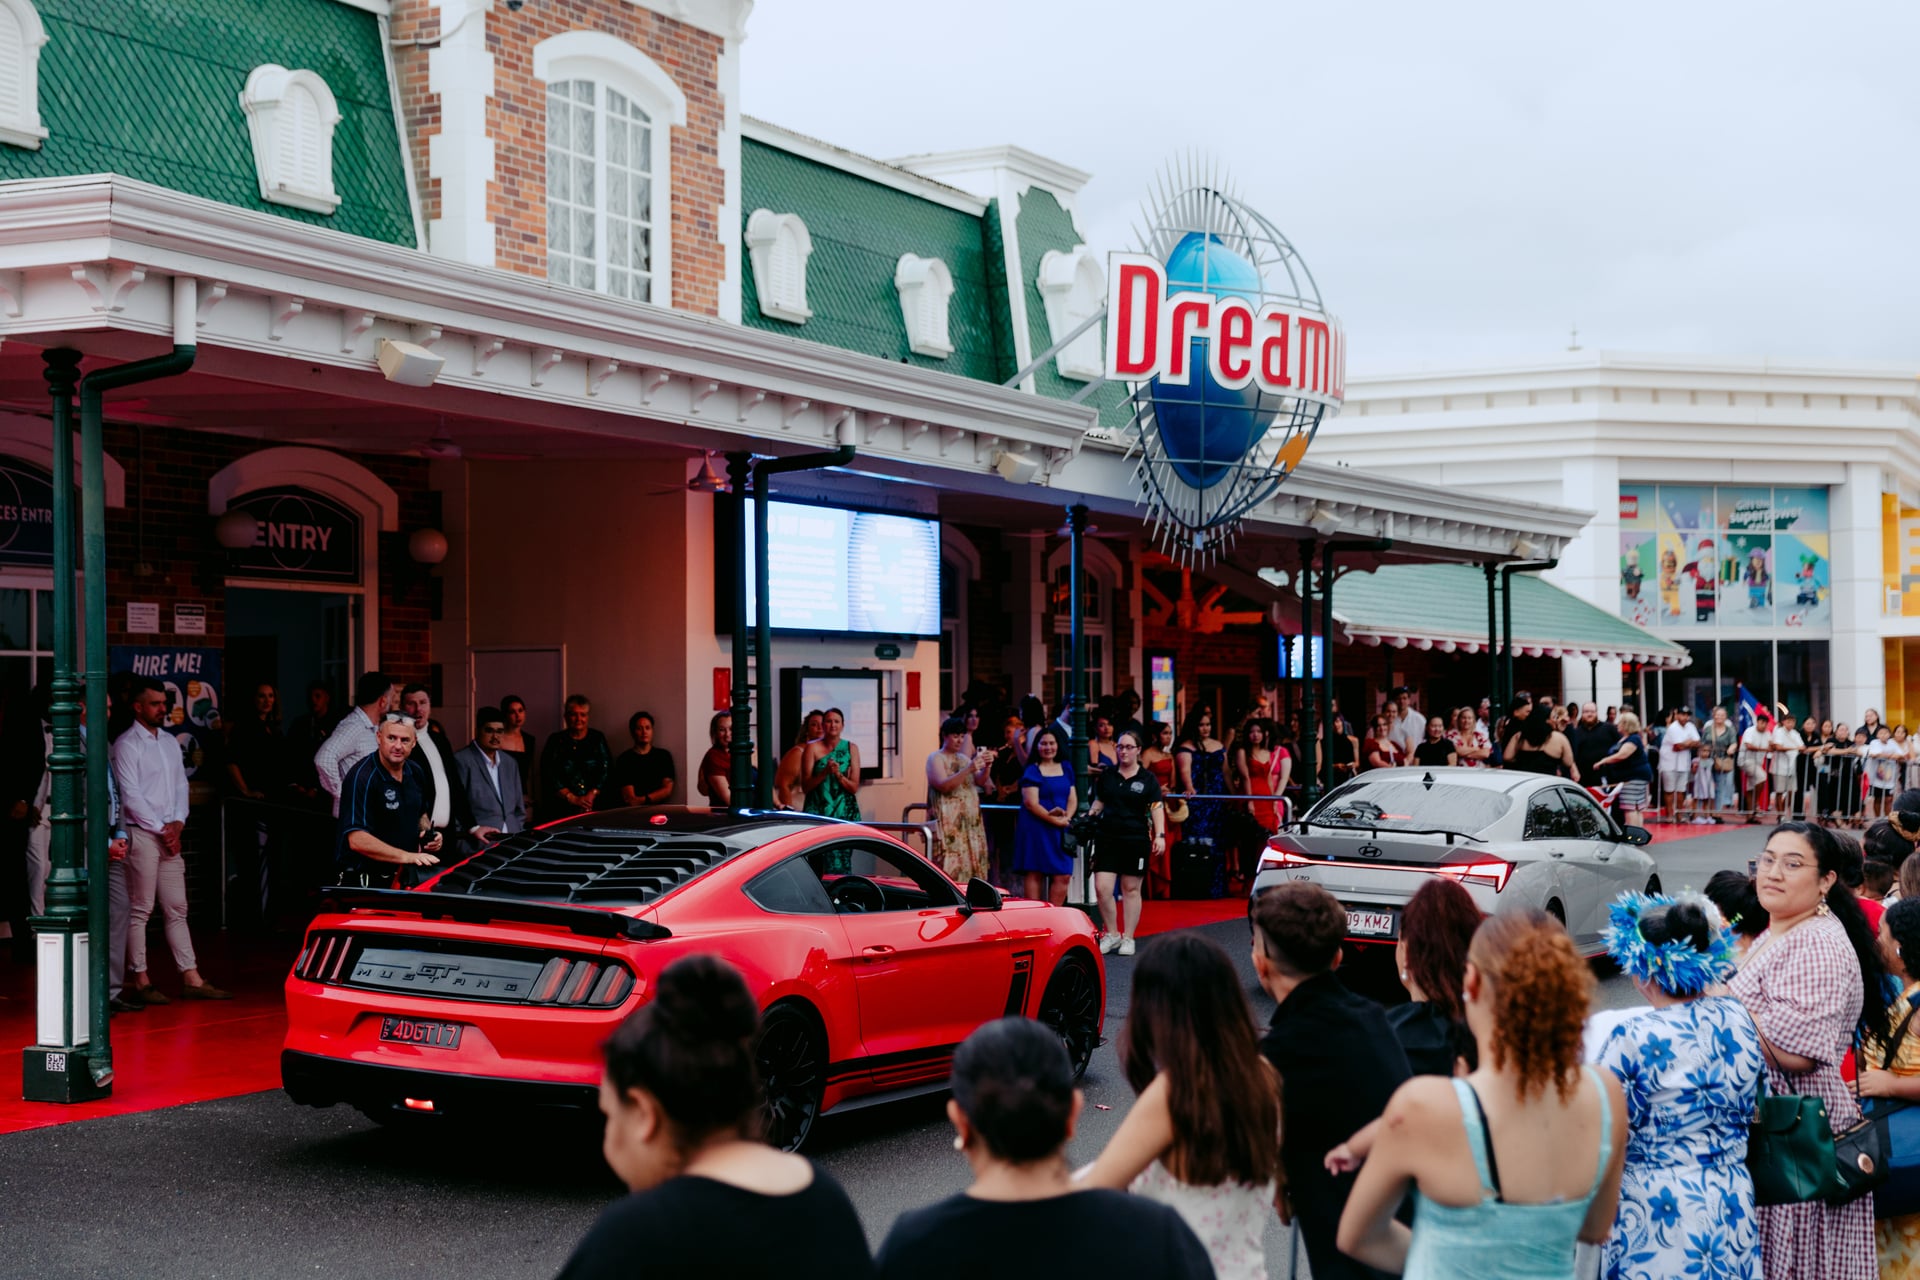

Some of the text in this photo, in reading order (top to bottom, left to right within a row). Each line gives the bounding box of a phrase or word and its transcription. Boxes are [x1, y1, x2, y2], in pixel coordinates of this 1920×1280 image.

[21, 506, 53, 524] ENTR
[253, 520, 333, 552] ENTRY
[132, 652, 202, 676] HIRE ME!
[357, 968, 518, 992] MUSTANG
[416, 962, 460, 978] GT
